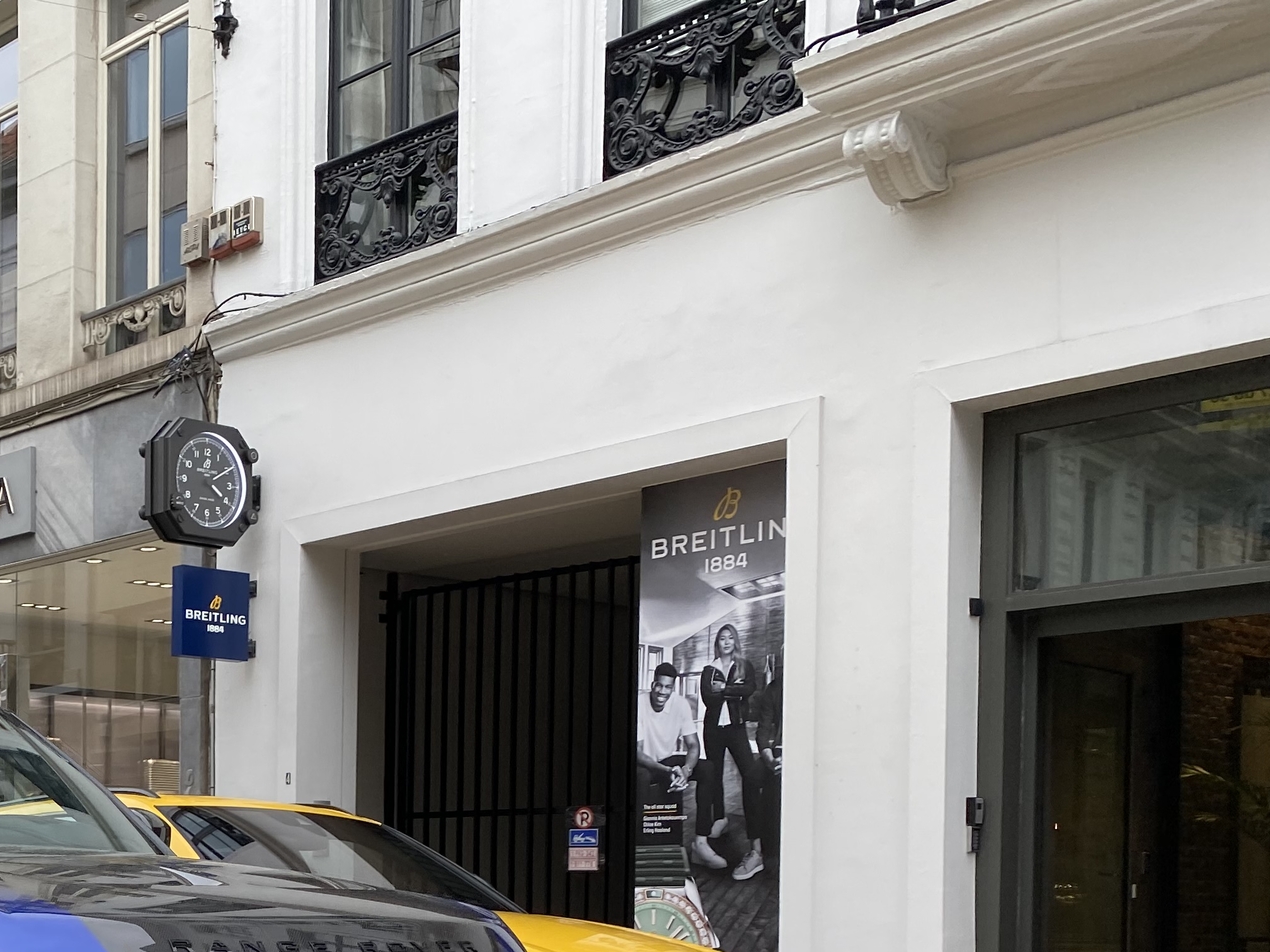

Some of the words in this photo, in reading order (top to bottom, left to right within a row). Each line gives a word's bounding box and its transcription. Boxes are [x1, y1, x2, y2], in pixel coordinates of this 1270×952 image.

[194, 450, 200, 458] 11
[204, 448, 211, 456] 12
[182, 474, 188, 482] 9
[226, 482, 232, 490] 3
[186, 490, 191, 498] 8
[224, 496, 228, 504] 4
[204, 508, 210, 517] 6
[215, 506, 221, 514] 5
[704, 552, 748, 574] 1884
[185, 608, 247, 626] BREITLING
[206, 624, 224, 634] 1884
